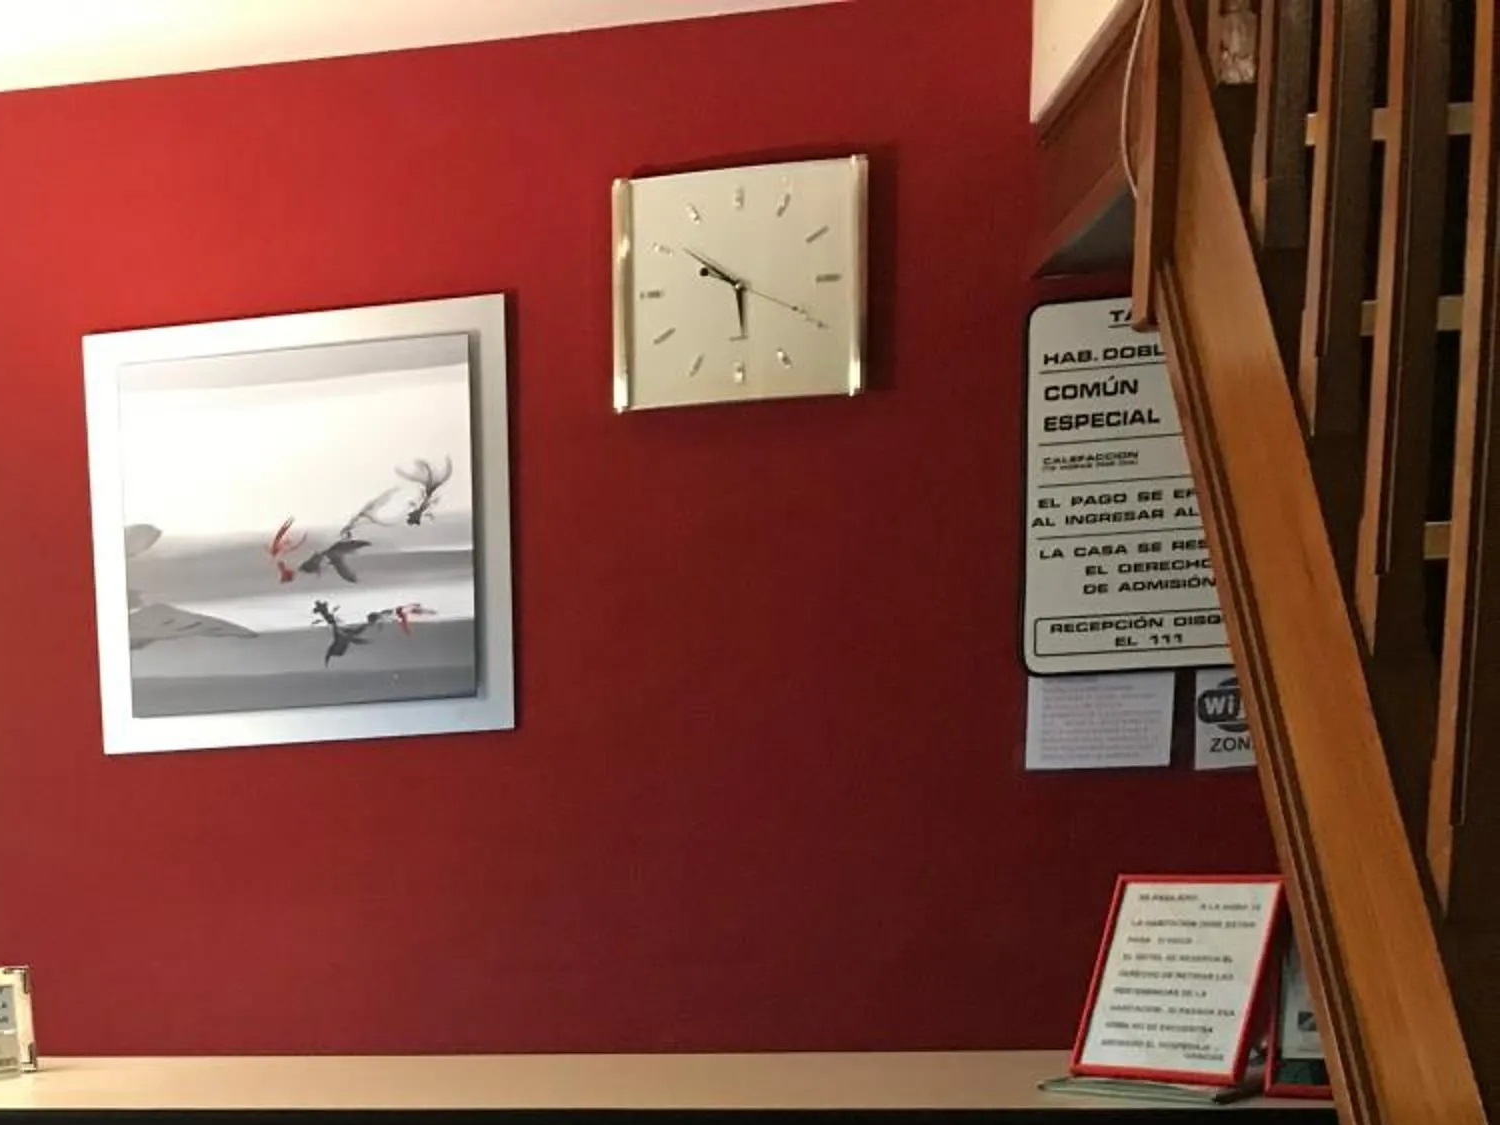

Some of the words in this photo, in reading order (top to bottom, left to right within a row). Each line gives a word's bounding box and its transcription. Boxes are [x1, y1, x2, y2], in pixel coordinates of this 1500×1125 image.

[1043, 350, 1097, 365] HAB.
[1103, 344, 1167, 361] DOBL
[1044, 375, 1139, 401] COMÚN
[1044, 409, 1160, 432] ESPECIAL
[1037, 498, 1060, 509] EL
[1071, 493, 1127, 507] PAGO
[1137, 490, 1163, 502] SE
[1032, 517, 1056, 528] AL
[1065, 508, 1164, 526] INGRESAR
[1174, 507, 1201, 518] AL
[1039, 548, 1064, 559] LA
[1074, 544, 1128, 557] CASA
[1138, 541, 1162, 553] SE
[1172, 539, 1211, 551] RES
[1085, 565, 1108, 576] EL
[1083, 584, 1108, 595] DE
[1118, 575, 1216, 592] ADMISIÓN
[1050, 616, 1163, 633] RECEPCIÓN
[1173, 615, 1221, 627] DISQ
[1115, 636, 1137, 647] EL
[1150, 634, 1183, 645] 111
[1210, 736, 1252, 753] ZON
